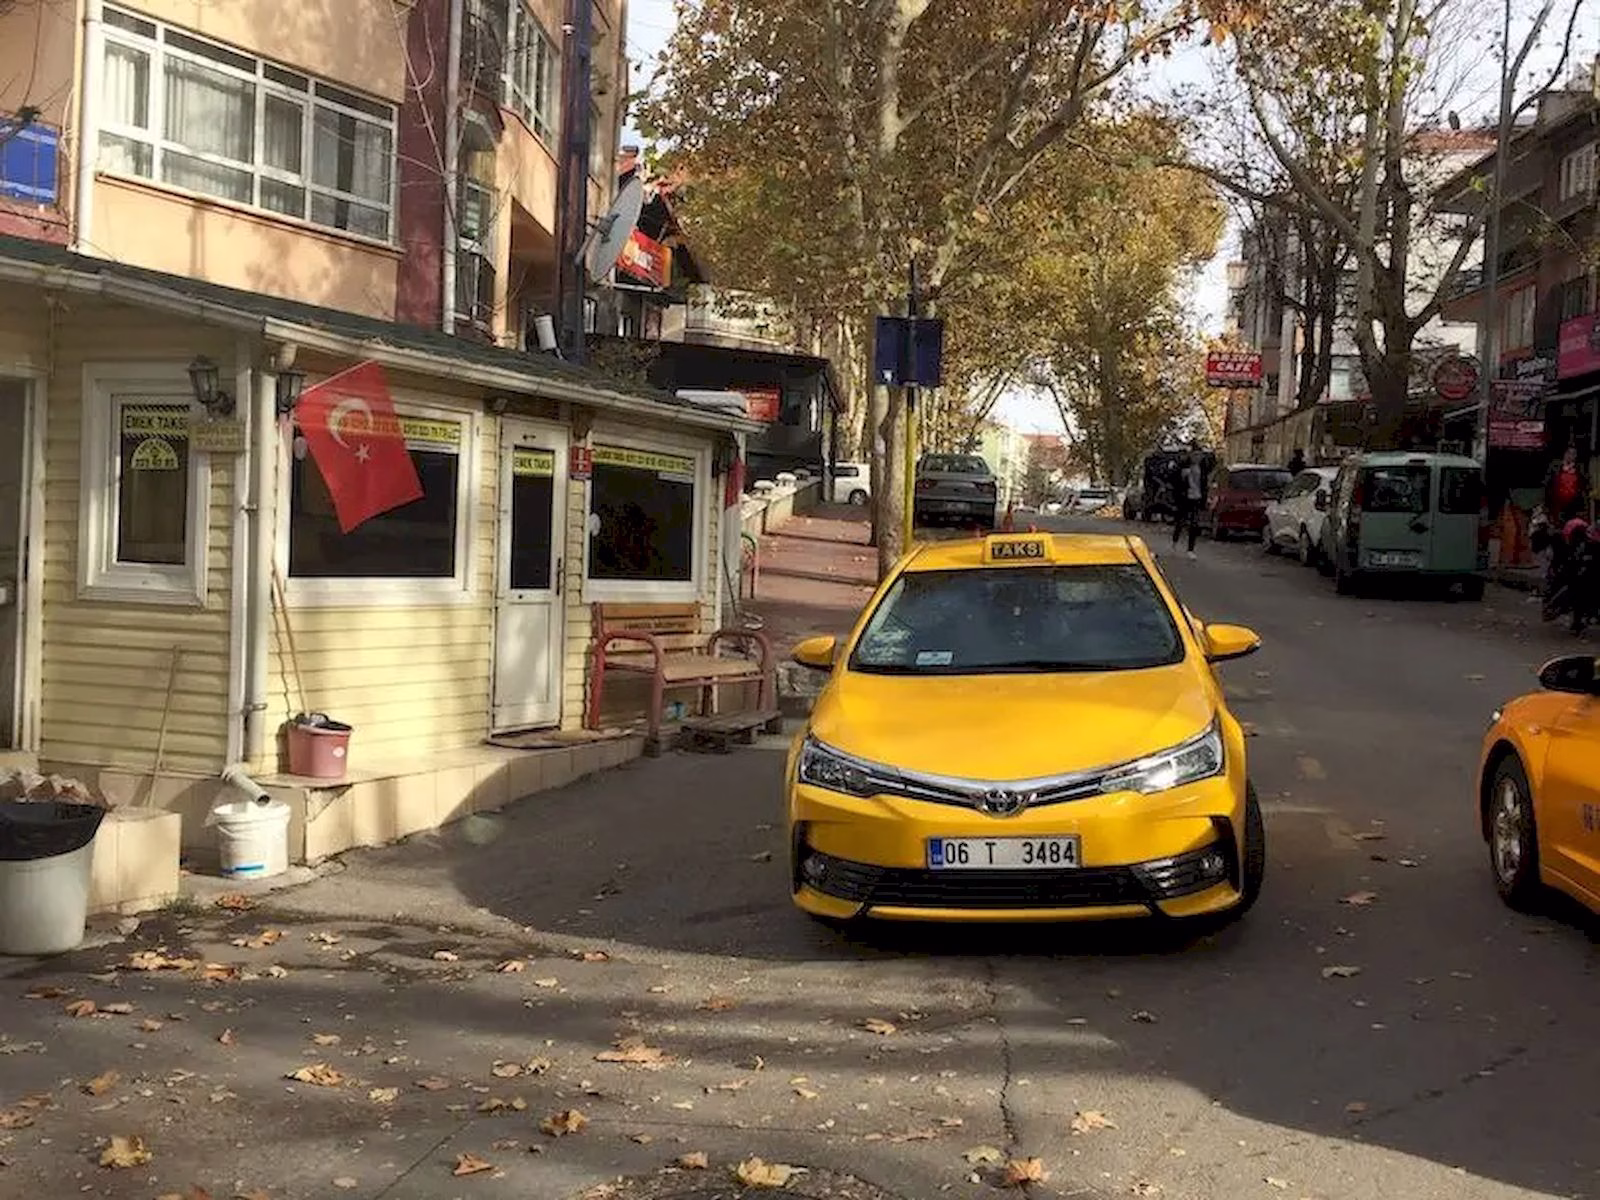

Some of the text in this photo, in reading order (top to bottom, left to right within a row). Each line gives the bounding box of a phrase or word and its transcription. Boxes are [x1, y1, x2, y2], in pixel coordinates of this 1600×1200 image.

[126, 415, 155, 429] EMEK
[945, 842, 969, 864] 06
[985, 841, 997, 864] T
[1022, 841, 1074, 864] 3484
